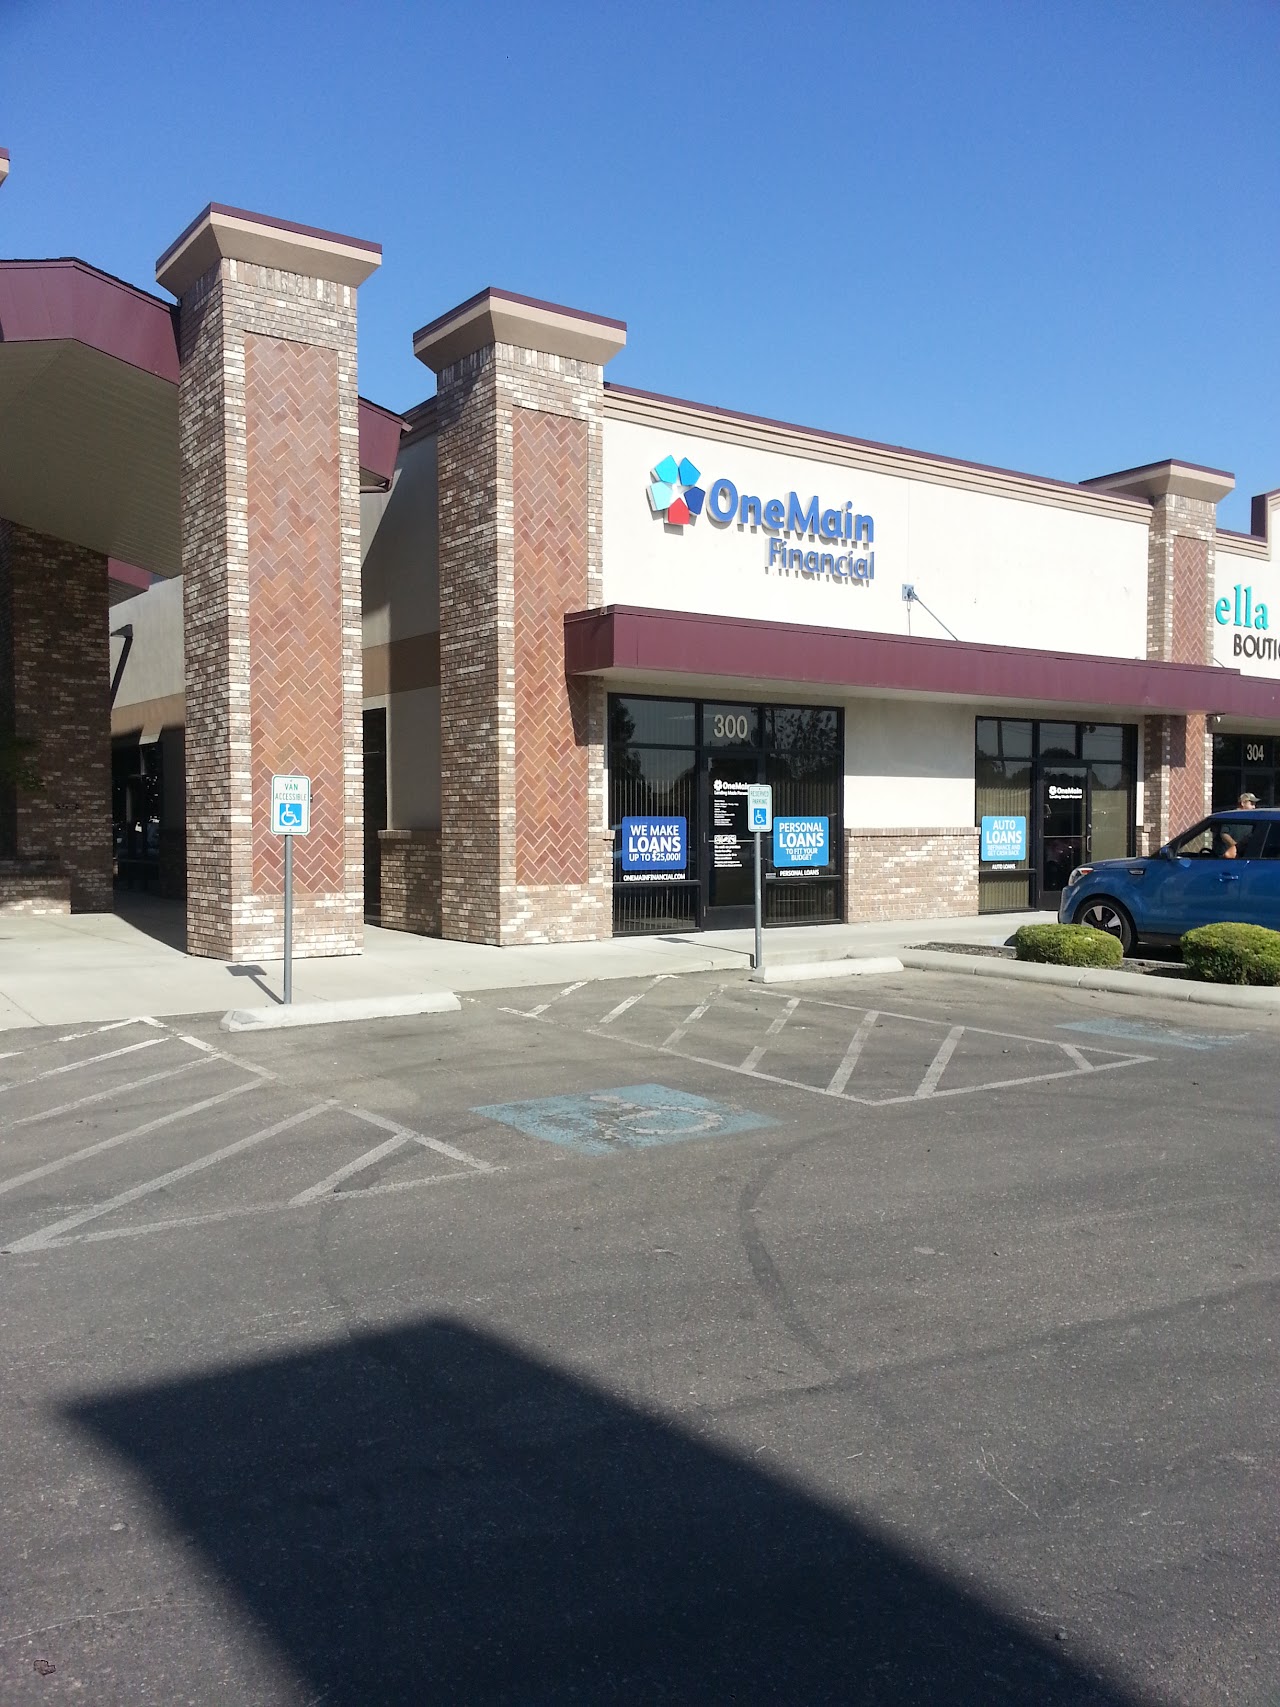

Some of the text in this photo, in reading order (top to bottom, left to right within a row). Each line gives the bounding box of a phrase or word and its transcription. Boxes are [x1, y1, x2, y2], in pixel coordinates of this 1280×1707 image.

[708, 478, 874, 543] OneMain
[767, 537, 875, 580] Financial
[1215, 584, 1269, 630] ella
[1234, 633, 1280, 661] BOUTI
[713, 714, 748, 739] 300
[1246, 743, 1265, 761] 304
[284, 783, 299, 791] VAN
[722, 781, 749, 790] OneMai
[1056, 786, 1082, 794] OneMain
[275, 792, 307, 801] ACCESSIBLE
[630, 824, 680, 836] WE MAKE
[779, 822, 825, 833] PERSONAL
[992, 819, 1016, 831] AUTO
[779, 832, 825, 848] LOANS
[986, 830, 1022, 844] LOANS
[628, 836, 681, 853] LOANS
[803, 847, 818, 855] YOUR
[629, 852, 681, 862] UP TO $25,000!
